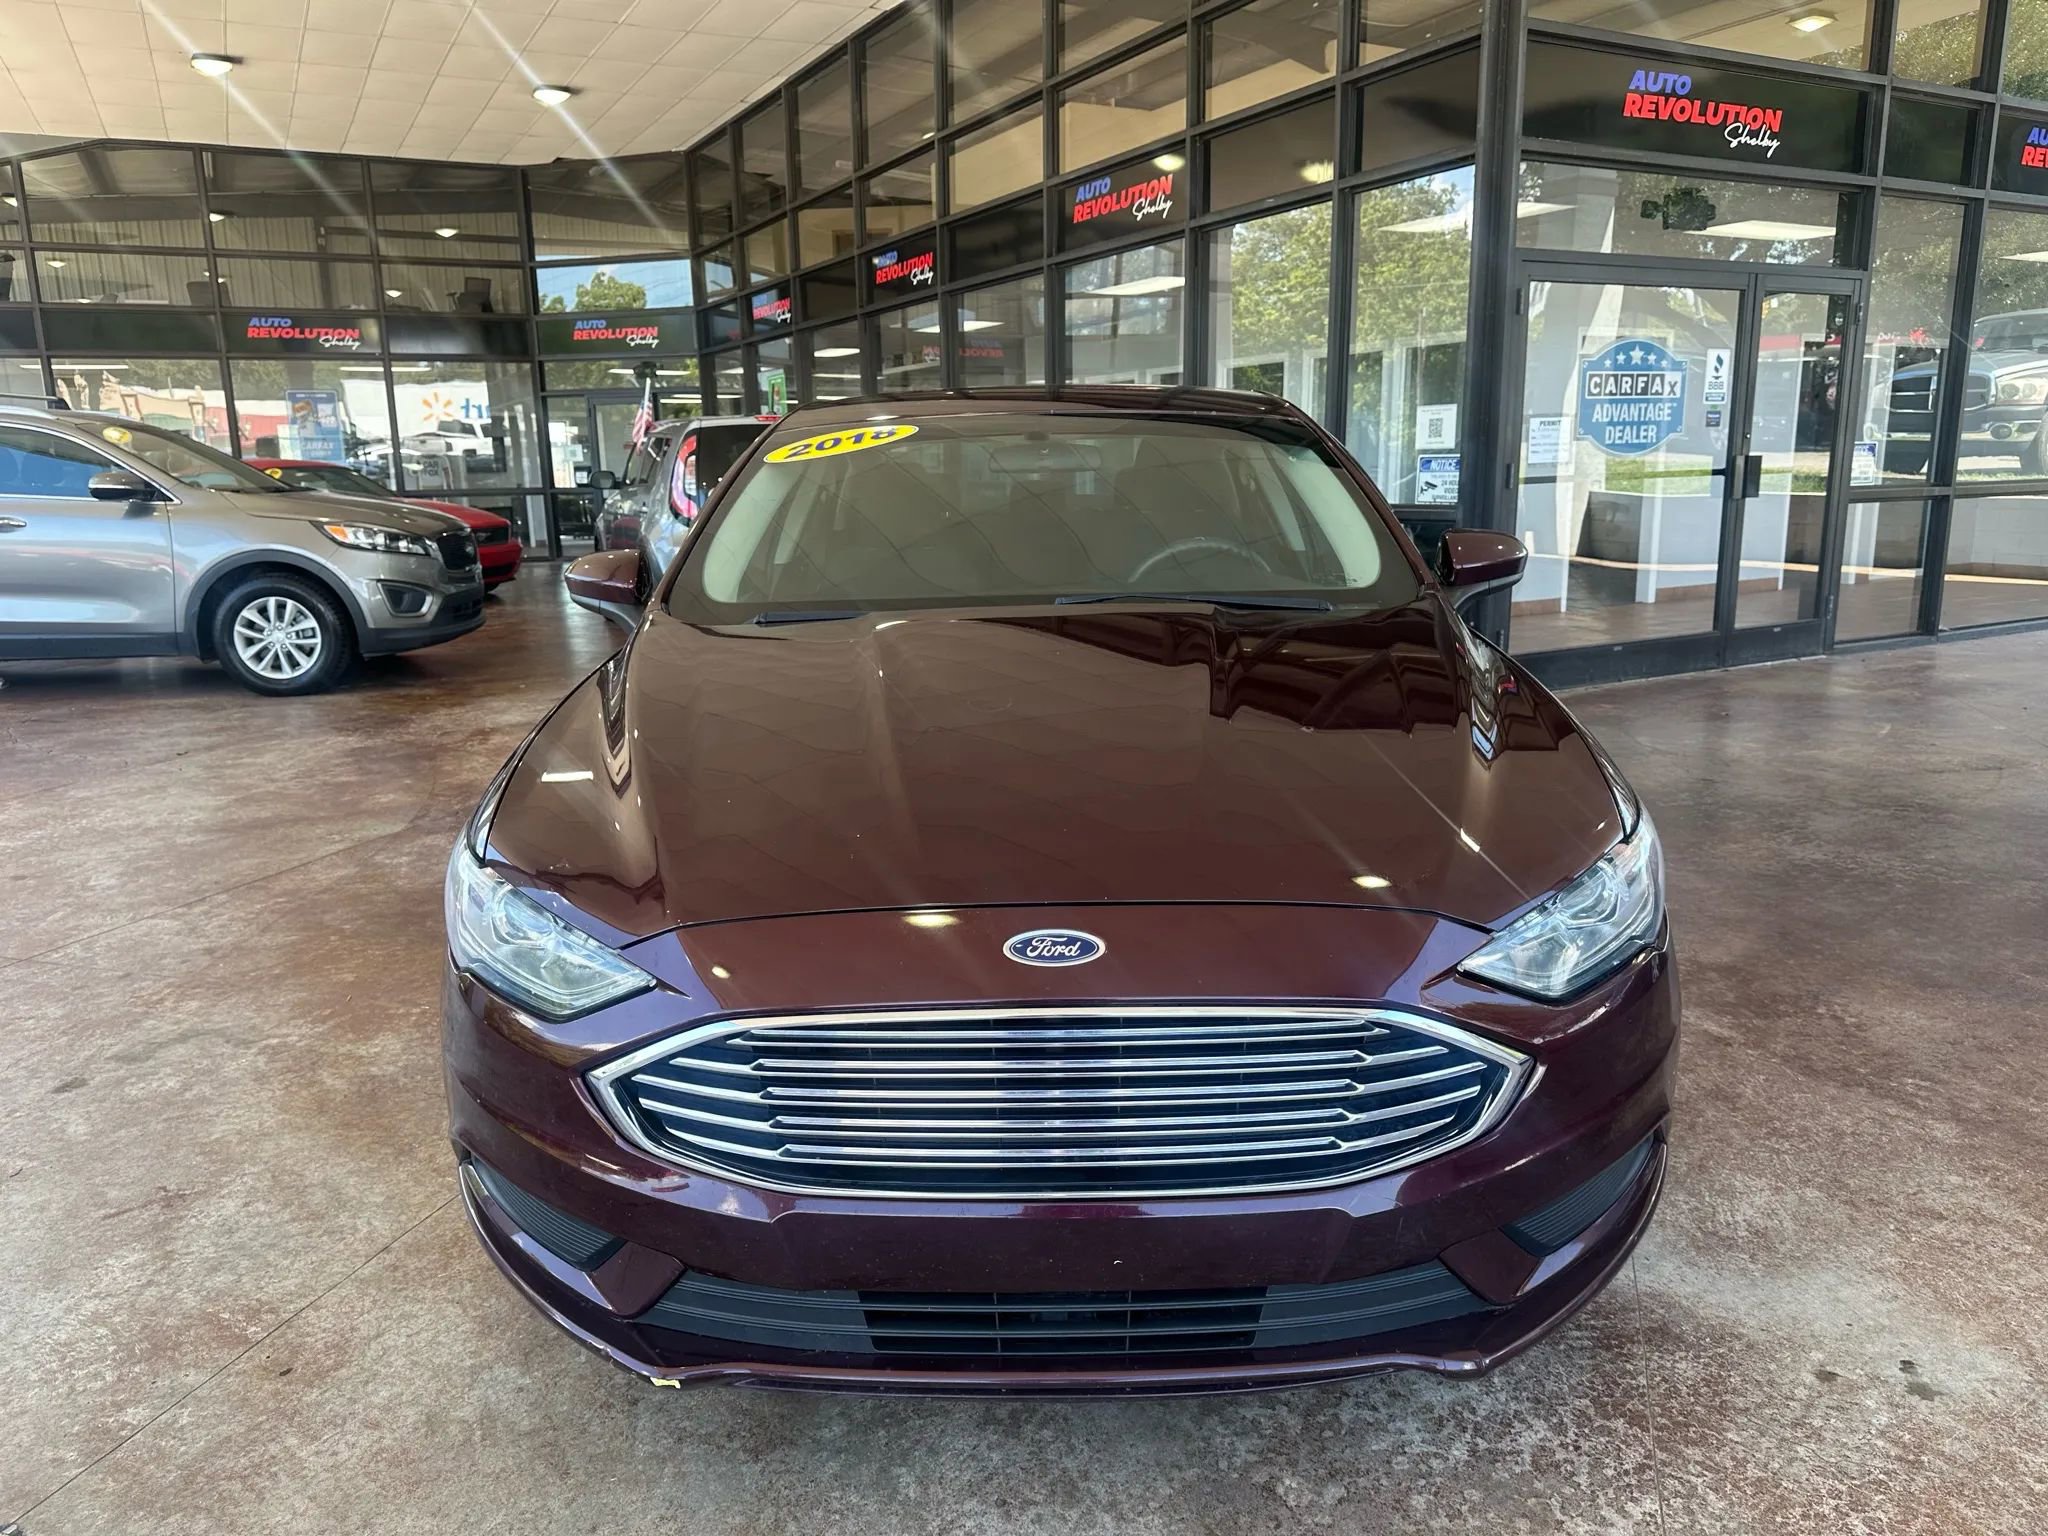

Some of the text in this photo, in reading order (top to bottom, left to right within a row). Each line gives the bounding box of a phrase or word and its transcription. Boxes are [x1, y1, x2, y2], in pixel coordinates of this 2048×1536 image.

[1629, 69, 1692, 95] AUTO
[1623, 92, 1783, 132] REVOLUTION
[1724, 122, 1780, 158] Shelby
[1073, 173, 1173, 223] REVOLUTION
[1076, 175, 1111, 203] AUTO
[1132, 192, 1173, 221] Shelby
[876, 252, 933, 284] REVOLUTION
[249, 317, 292, 327] AUTO
[575, 320, 607, 329] AUTO
[247, 328, 360, 339] REVOLUTION
[319, 335, 361, 350] Shelby
[573, 326, 658, 340] REVOLUTION
[626, 334, 659, 348] Shelby
[1590, 375, 1678, 396] CARFAX
[1592, 403, 1671, 423] ADVANTAGE
[1605, 425, 1657, 444] DEALER
[1430, 459, 1456, 471] NOTICE
[1026, 936, 1081, 957] Ford
